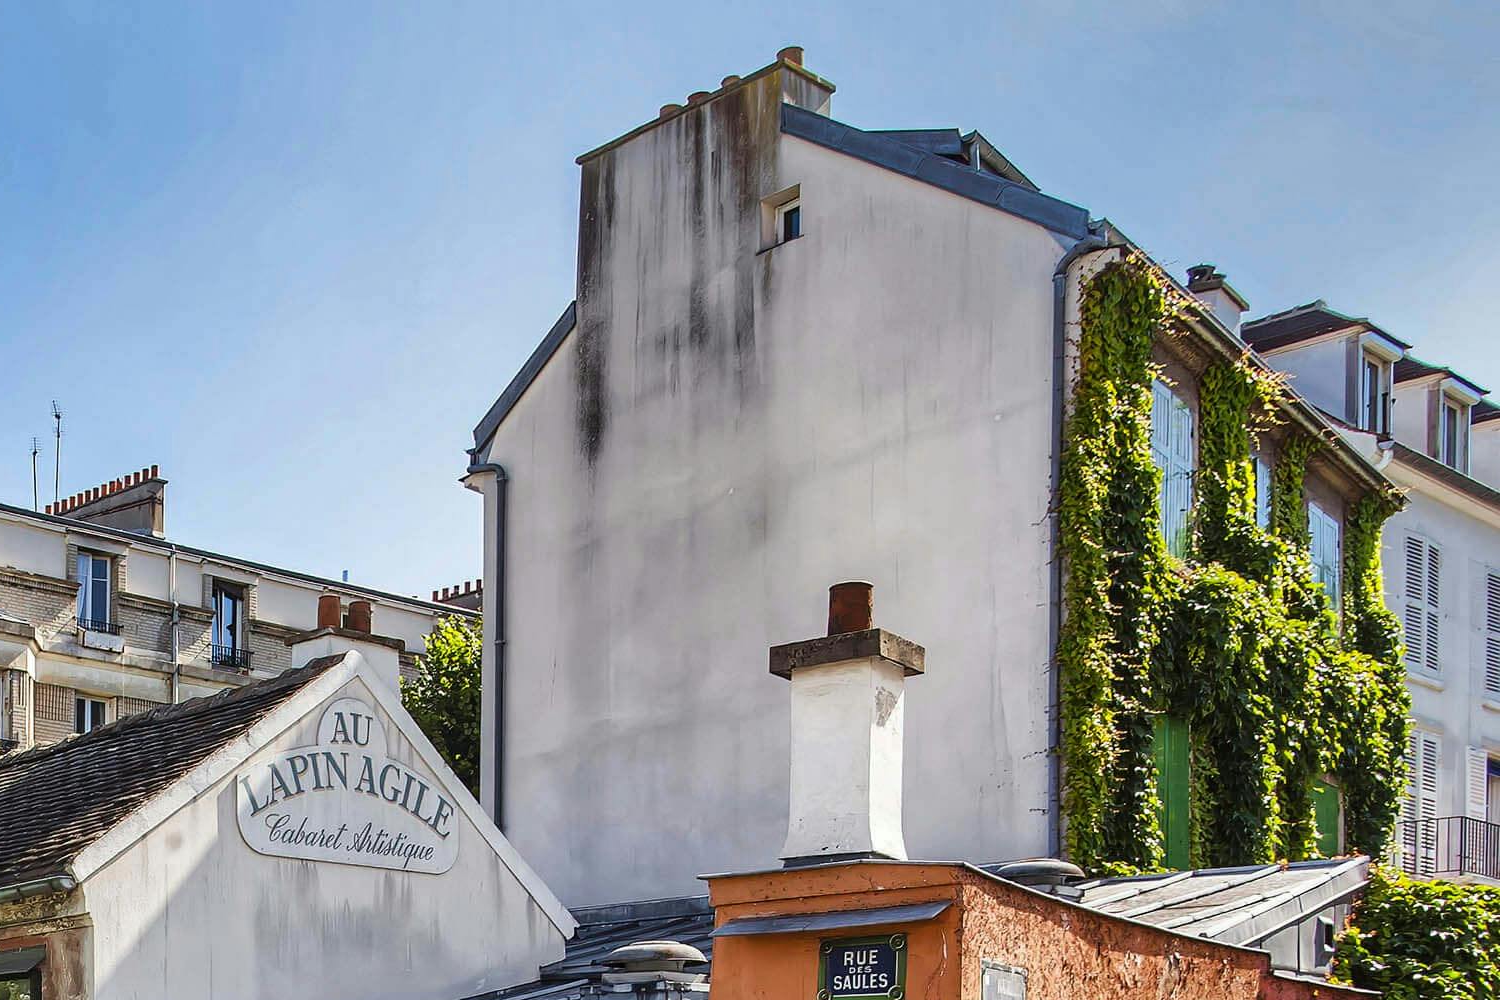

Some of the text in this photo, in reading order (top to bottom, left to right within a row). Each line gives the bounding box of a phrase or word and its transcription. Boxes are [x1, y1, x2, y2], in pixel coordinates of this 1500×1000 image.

[330, 712, 373, 746] AU
[239, 752, 454, 840] LAPIN AGILE
[265, 813, 434, 869] Cabaret Artistique
[843, 950, 879, 966] RUE
[849, 966, 872, 974] DES
[833, 973, 888, 990] SAULES
